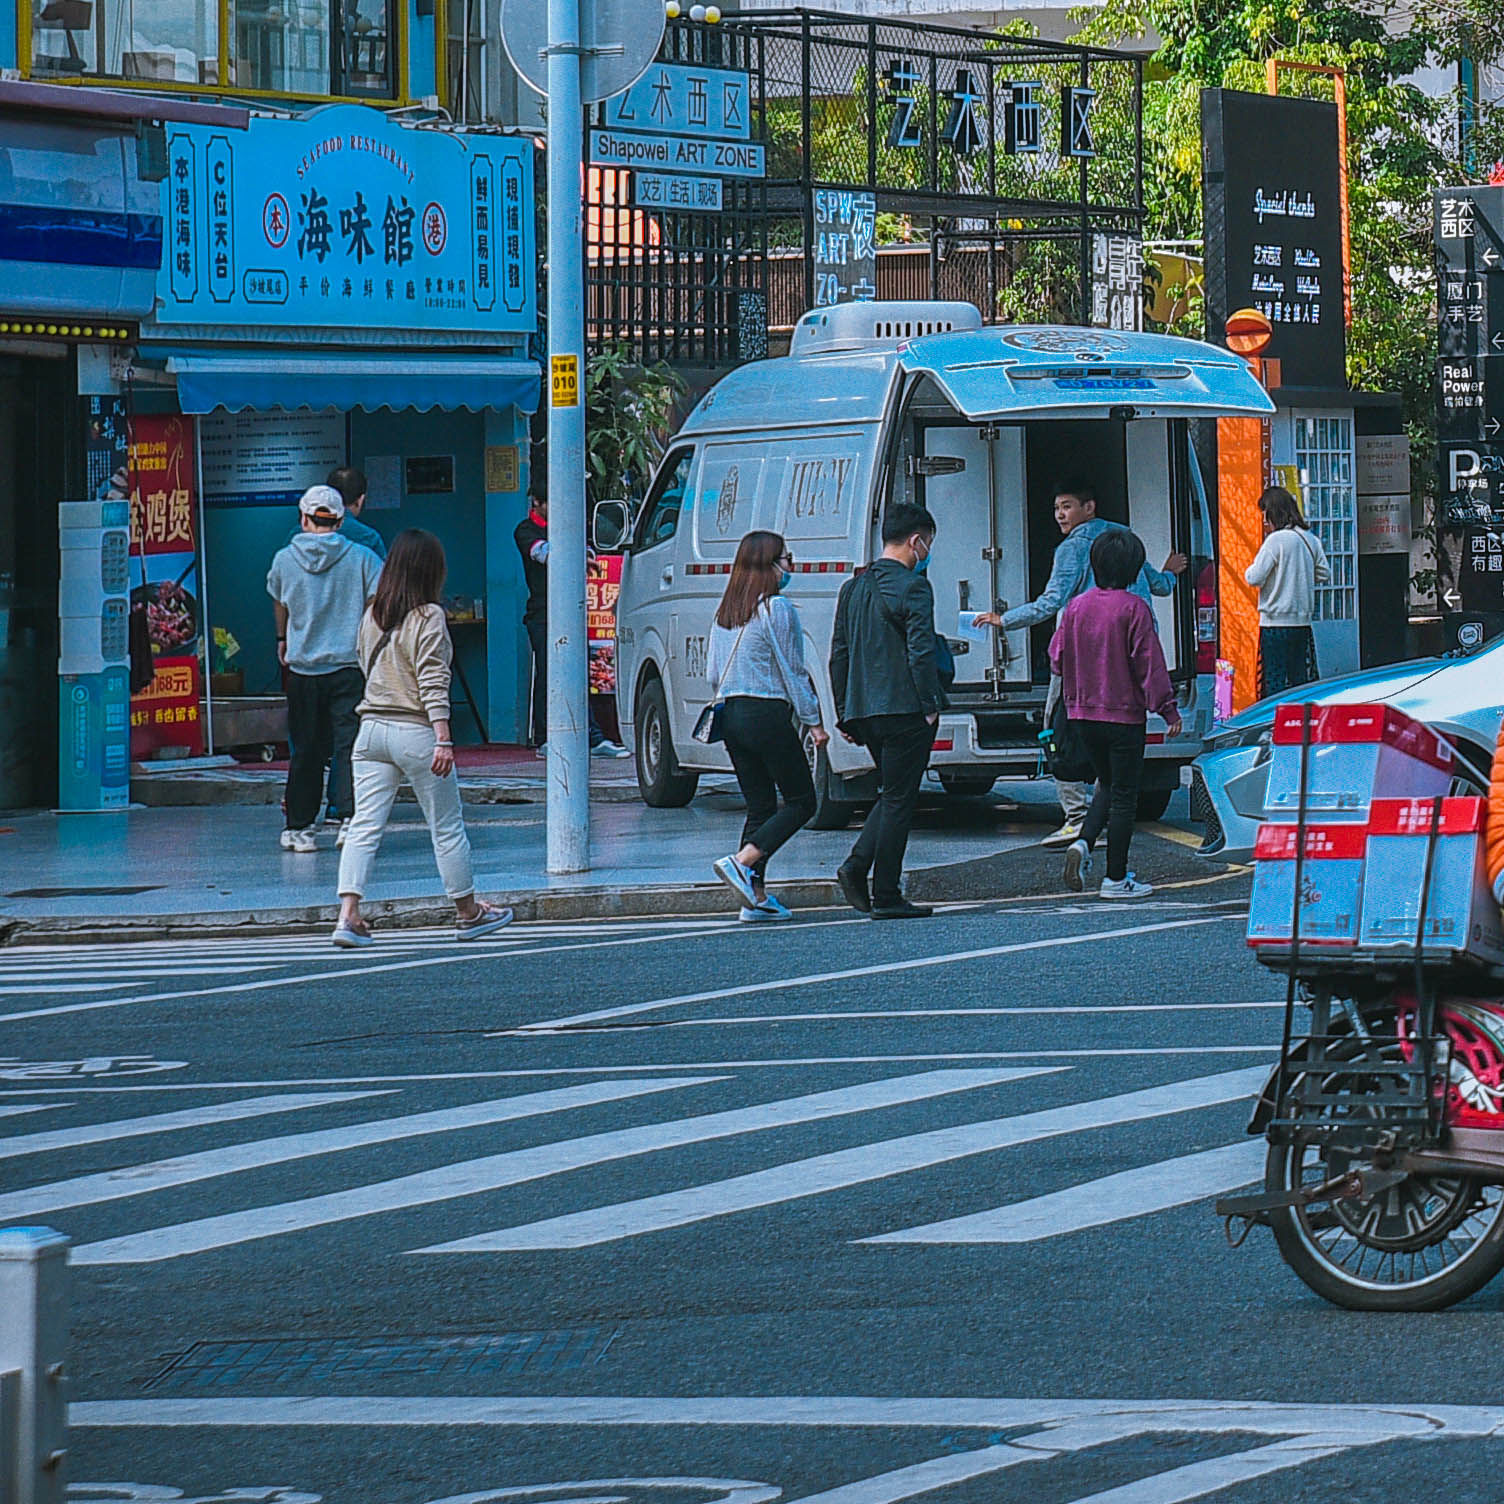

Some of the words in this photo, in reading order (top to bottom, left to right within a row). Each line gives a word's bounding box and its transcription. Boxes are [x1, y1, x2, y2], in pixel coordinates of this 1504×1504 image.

[891, 59, 1097, 157] 艺术西区
[297, 136, 343, 180] SEAFOOD
[598, 134, 669, 162] Shapowei
[676, 142, 705, 164] ART
[715, 146, 757, 168] ZONE
[175, 156, 191, 279] 本港海味
[214, 161, 228, 279] C位天台
[816, 191, 852, 225] SPW
[1440, 198, 1475, 218] 艺术
[297, 187, 416, 268] 海味館
[1440, 218, 1475, 239] 西区
[816, 232, 849, 265] ART
[1447, 282, 1483, 300] 厦门
[1447, 304, 1483, 322] 手艺
[553, 375, 576, 390] 010
[1443, 365, 1473, 379] Real
[1443, 379, 1485, 394] Power
[1449, 449, 1480, 492] P
[1471, 535, 1502, 553] 西区
[1471, 555, 1503, 572] 有趣
